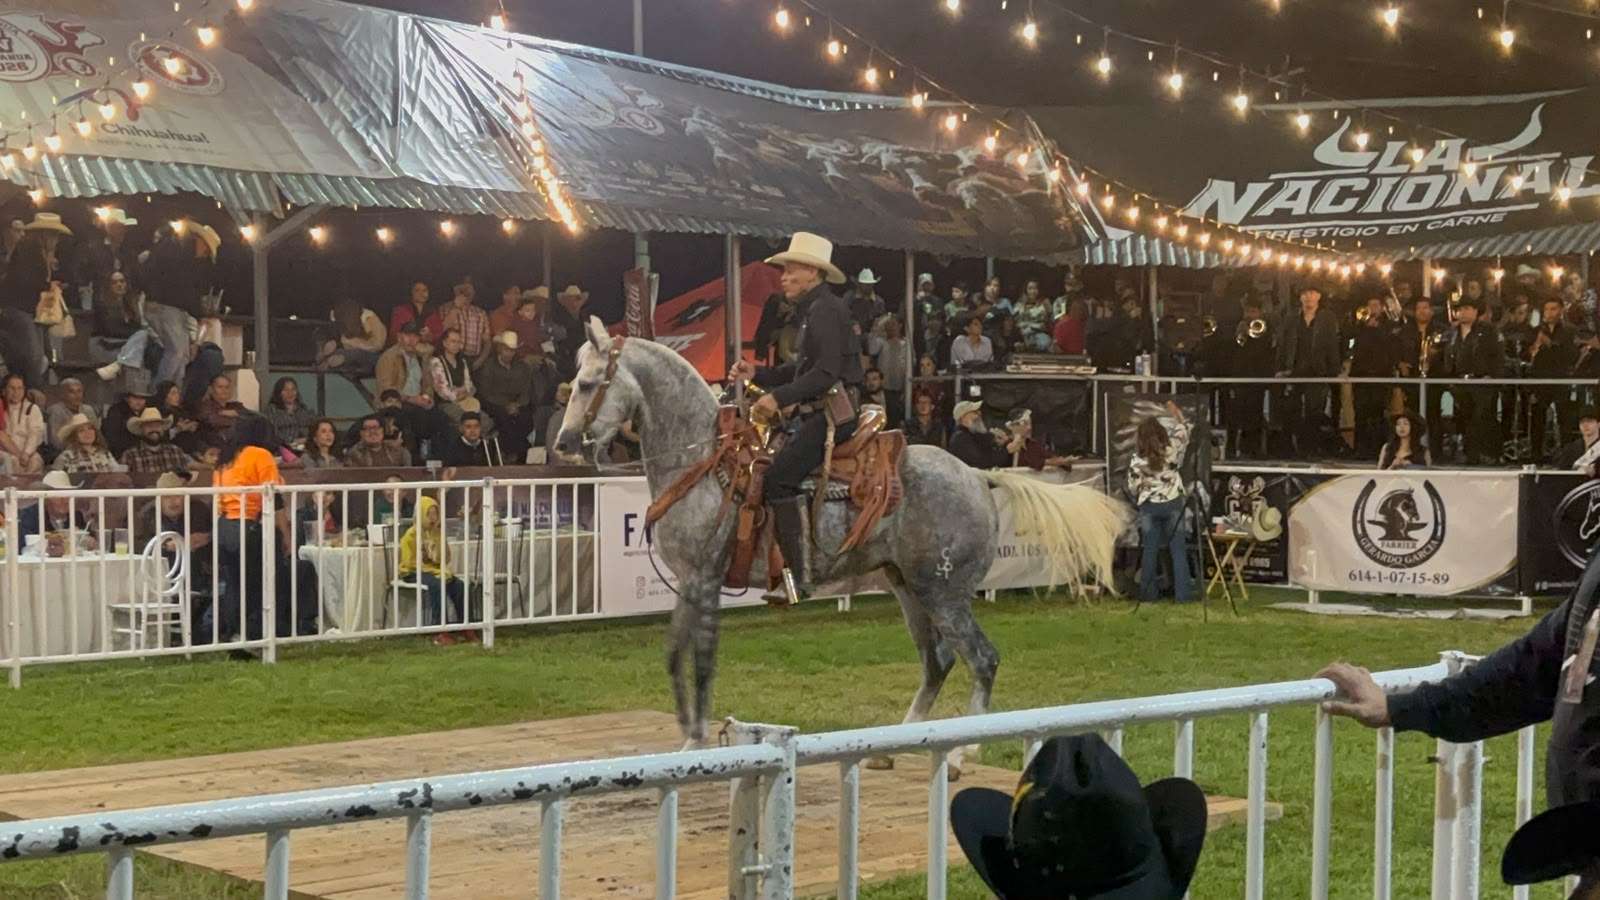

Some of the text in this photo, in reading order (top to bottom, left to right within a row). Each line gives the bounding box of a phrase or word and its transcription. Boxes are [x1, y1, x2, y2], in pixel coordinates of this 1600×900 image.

[1369, 138, 1467, 174] LA
[1181, 155, 1600, 226] NACIONAL
[1255, 212, 1508, 240] PRESTIGIO EN CARNE
[1360, 536, 1403, 564] GERARDO
[1348, 569, 1450, 585] 614-1-07-15-89
